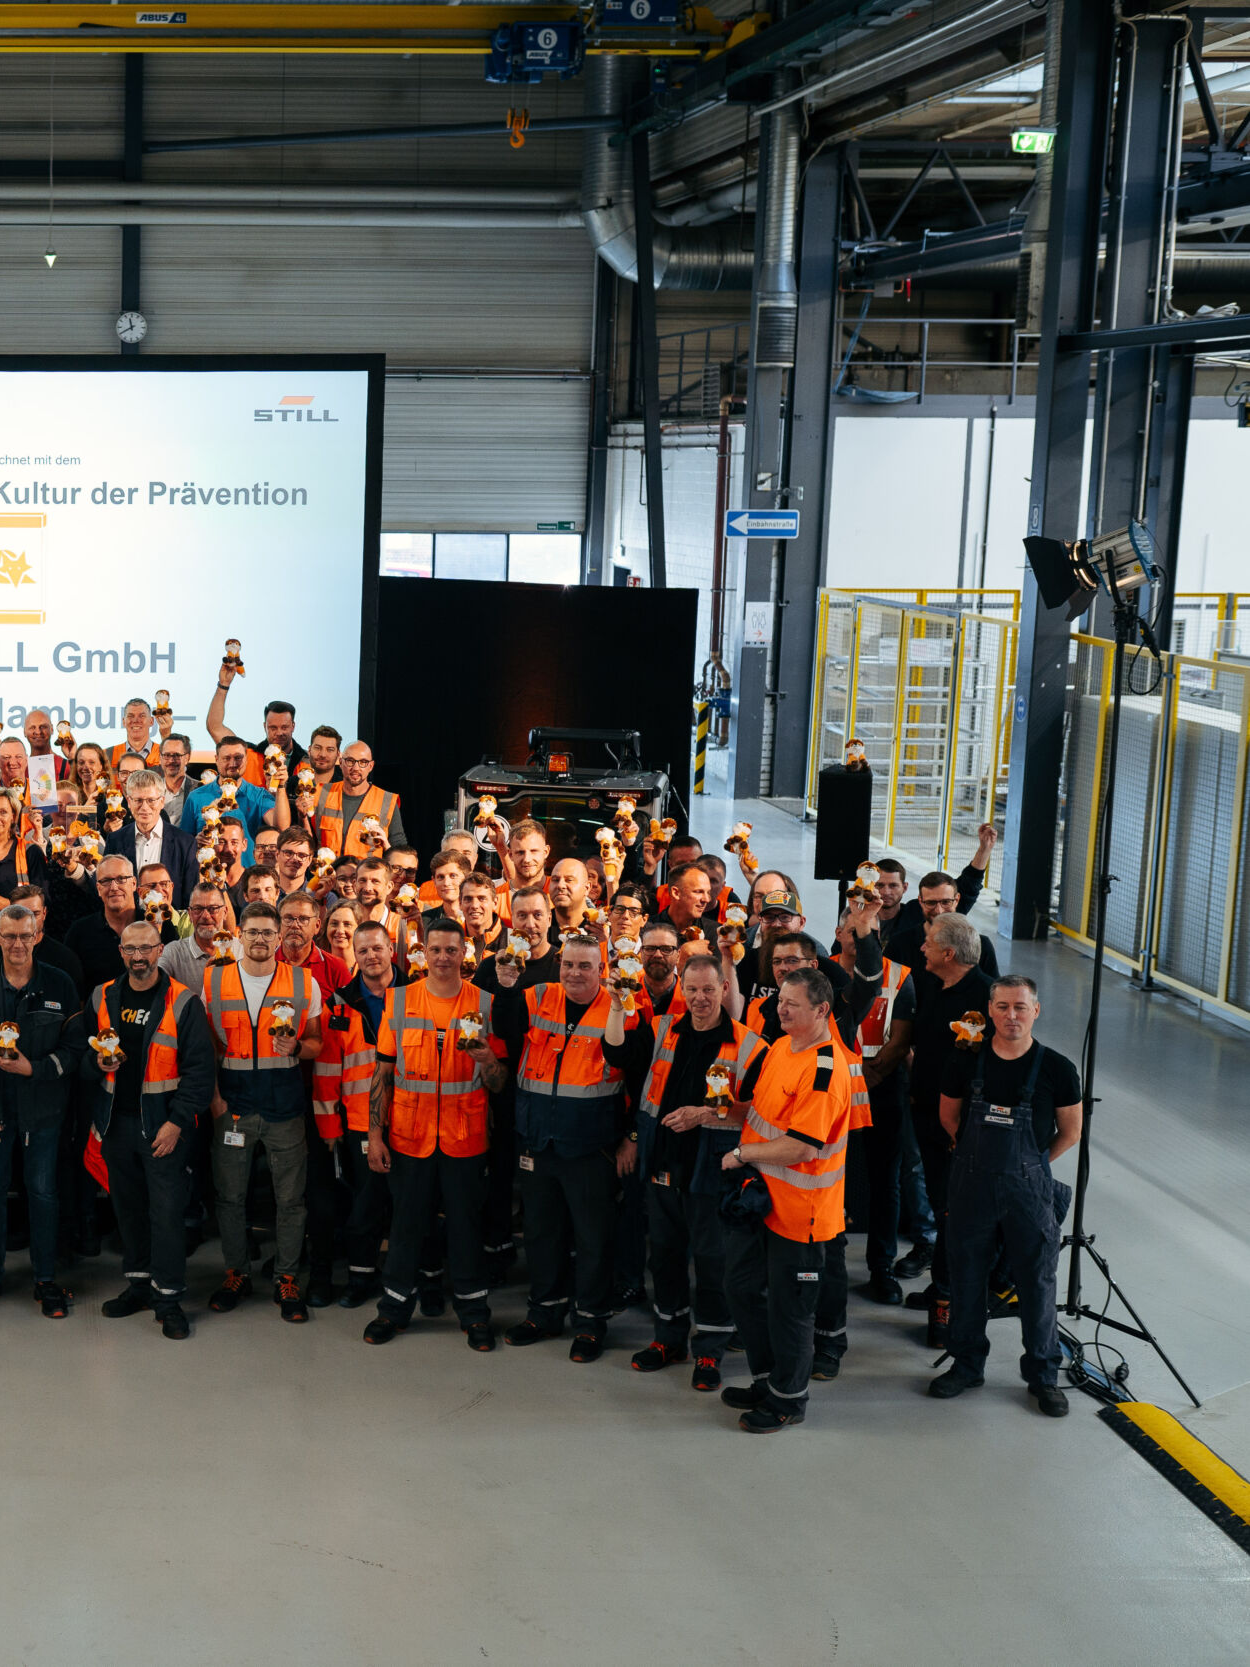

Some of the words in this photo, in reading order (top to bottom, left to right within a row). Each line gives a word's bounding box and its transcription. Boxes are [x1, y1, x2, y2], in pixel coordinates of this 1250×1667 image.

[138, 14, 169, 22] ABUS
[254, 409, 339, 422] STILL
[34, 454, 52, 465] mit
[56, 454, 81, 465] dem
[91, 481, 138, 505] der
[148, 480, 308, 506] Prävention
[746, 520, 794, 529] Einbahnstraße
[52, 640, 177, 674] GmbH
[751, 983, 757, 995] I
[759, 986, 778, 999] SE
